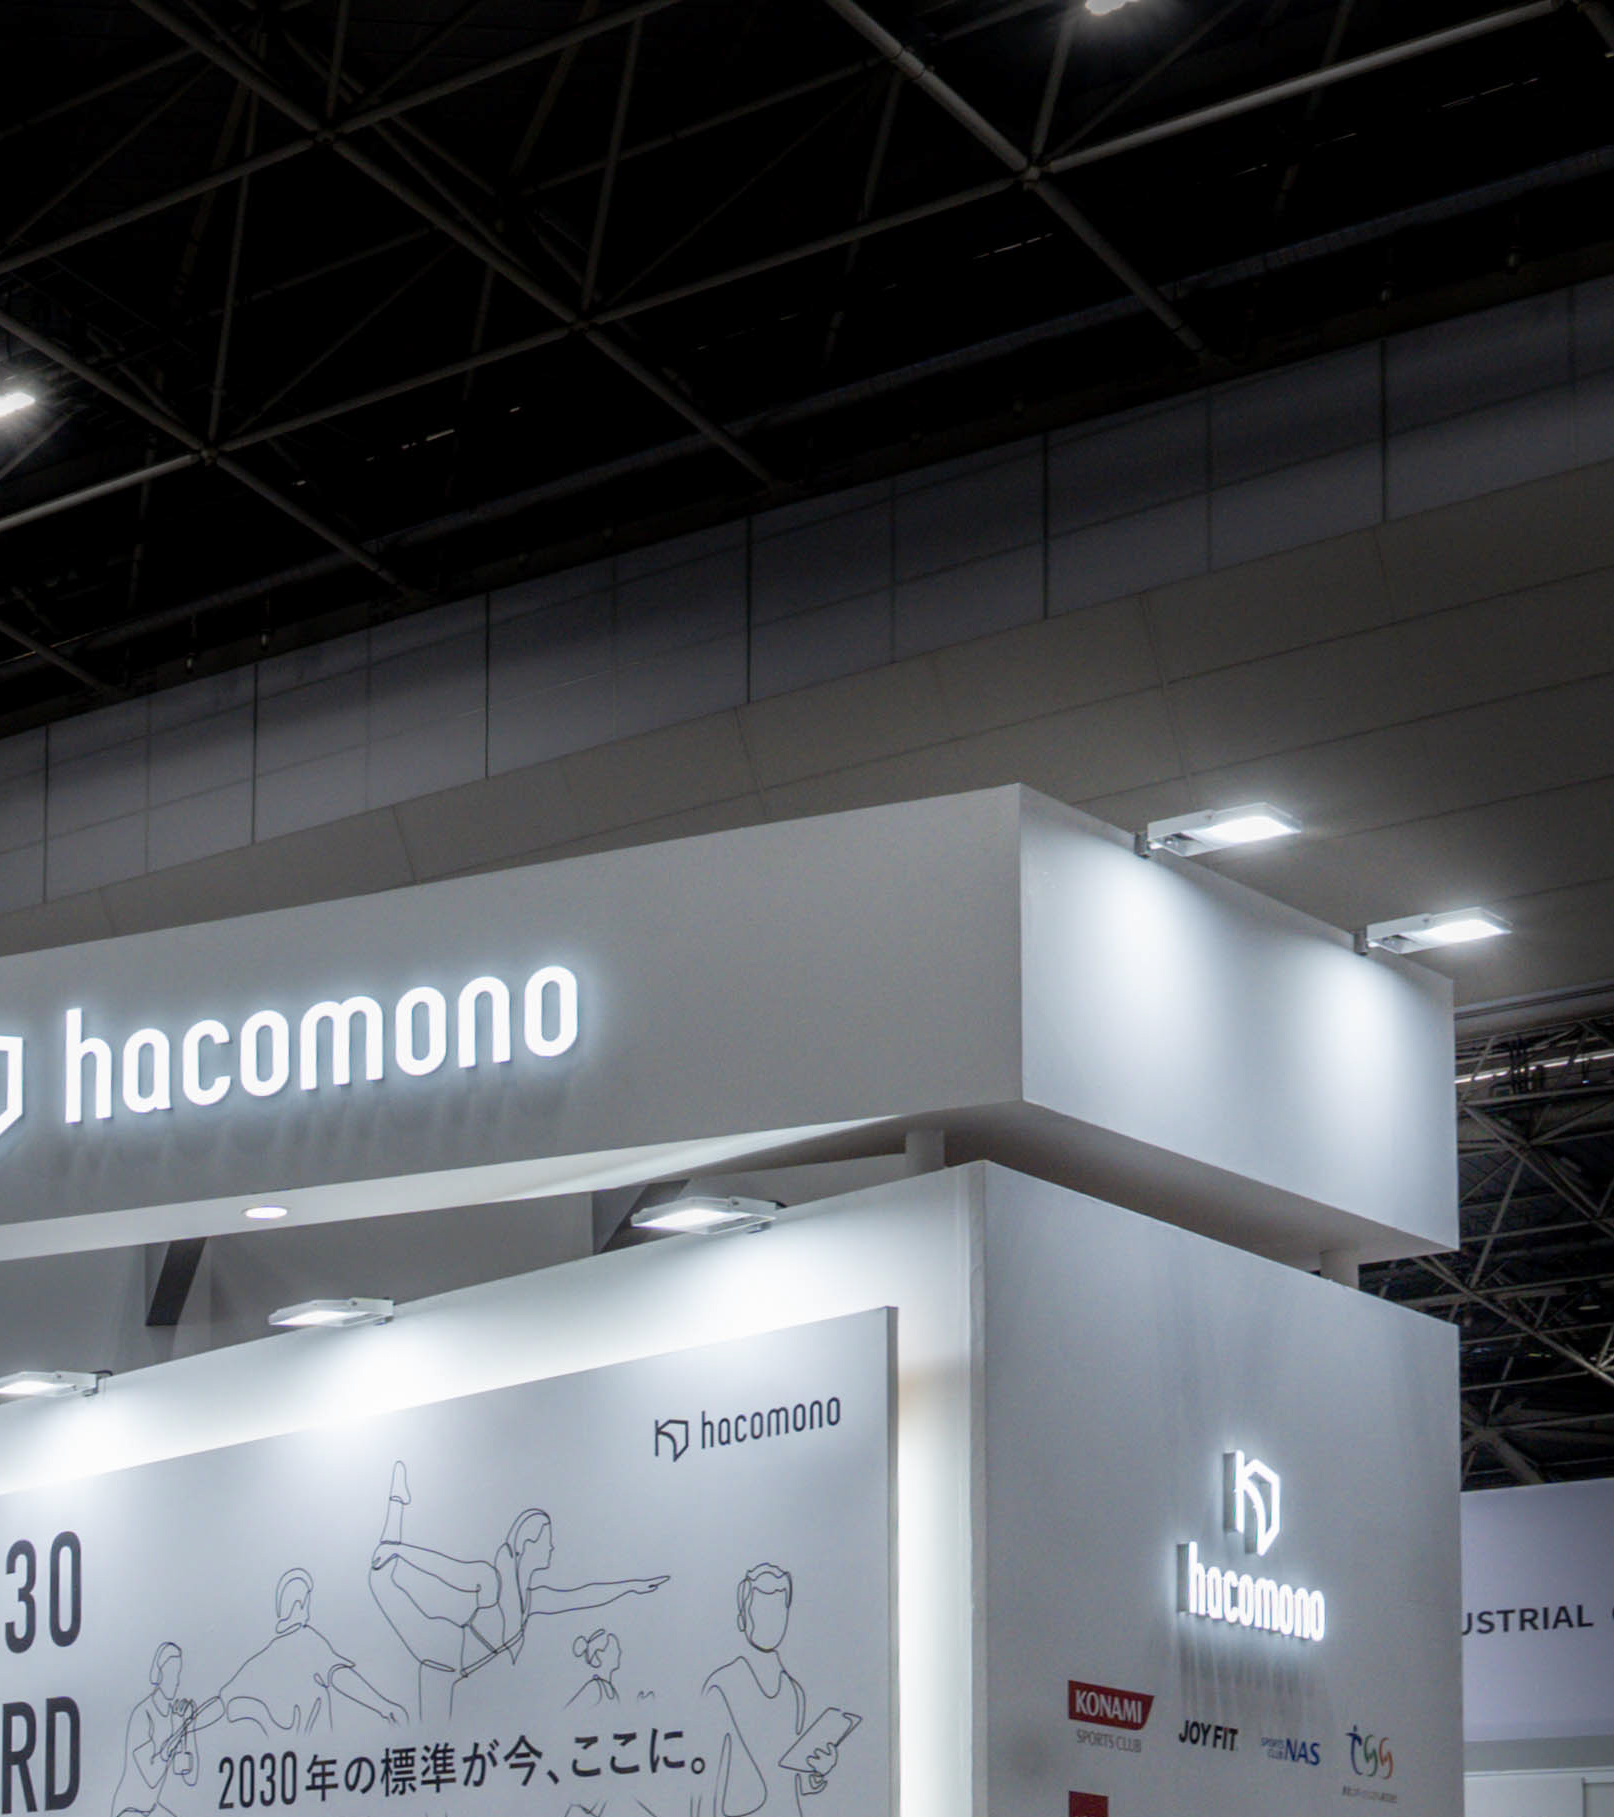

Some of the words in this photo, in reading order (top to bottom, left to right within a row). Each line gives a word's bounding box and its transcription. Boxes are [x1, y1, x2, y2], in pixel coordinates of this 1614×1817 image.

[64, 965, 579, 1124] hacomono
[700, 1396, 842, 1451] hacomono
[1186, 1540, 1327, 1643] hacomono
[1074, 1689, 1143, 1725] KONAMI
[218, 1727, 706, 1811] 2030年の標準が今、ここに。
[1285, 1737, 1321, 1767] NAS
